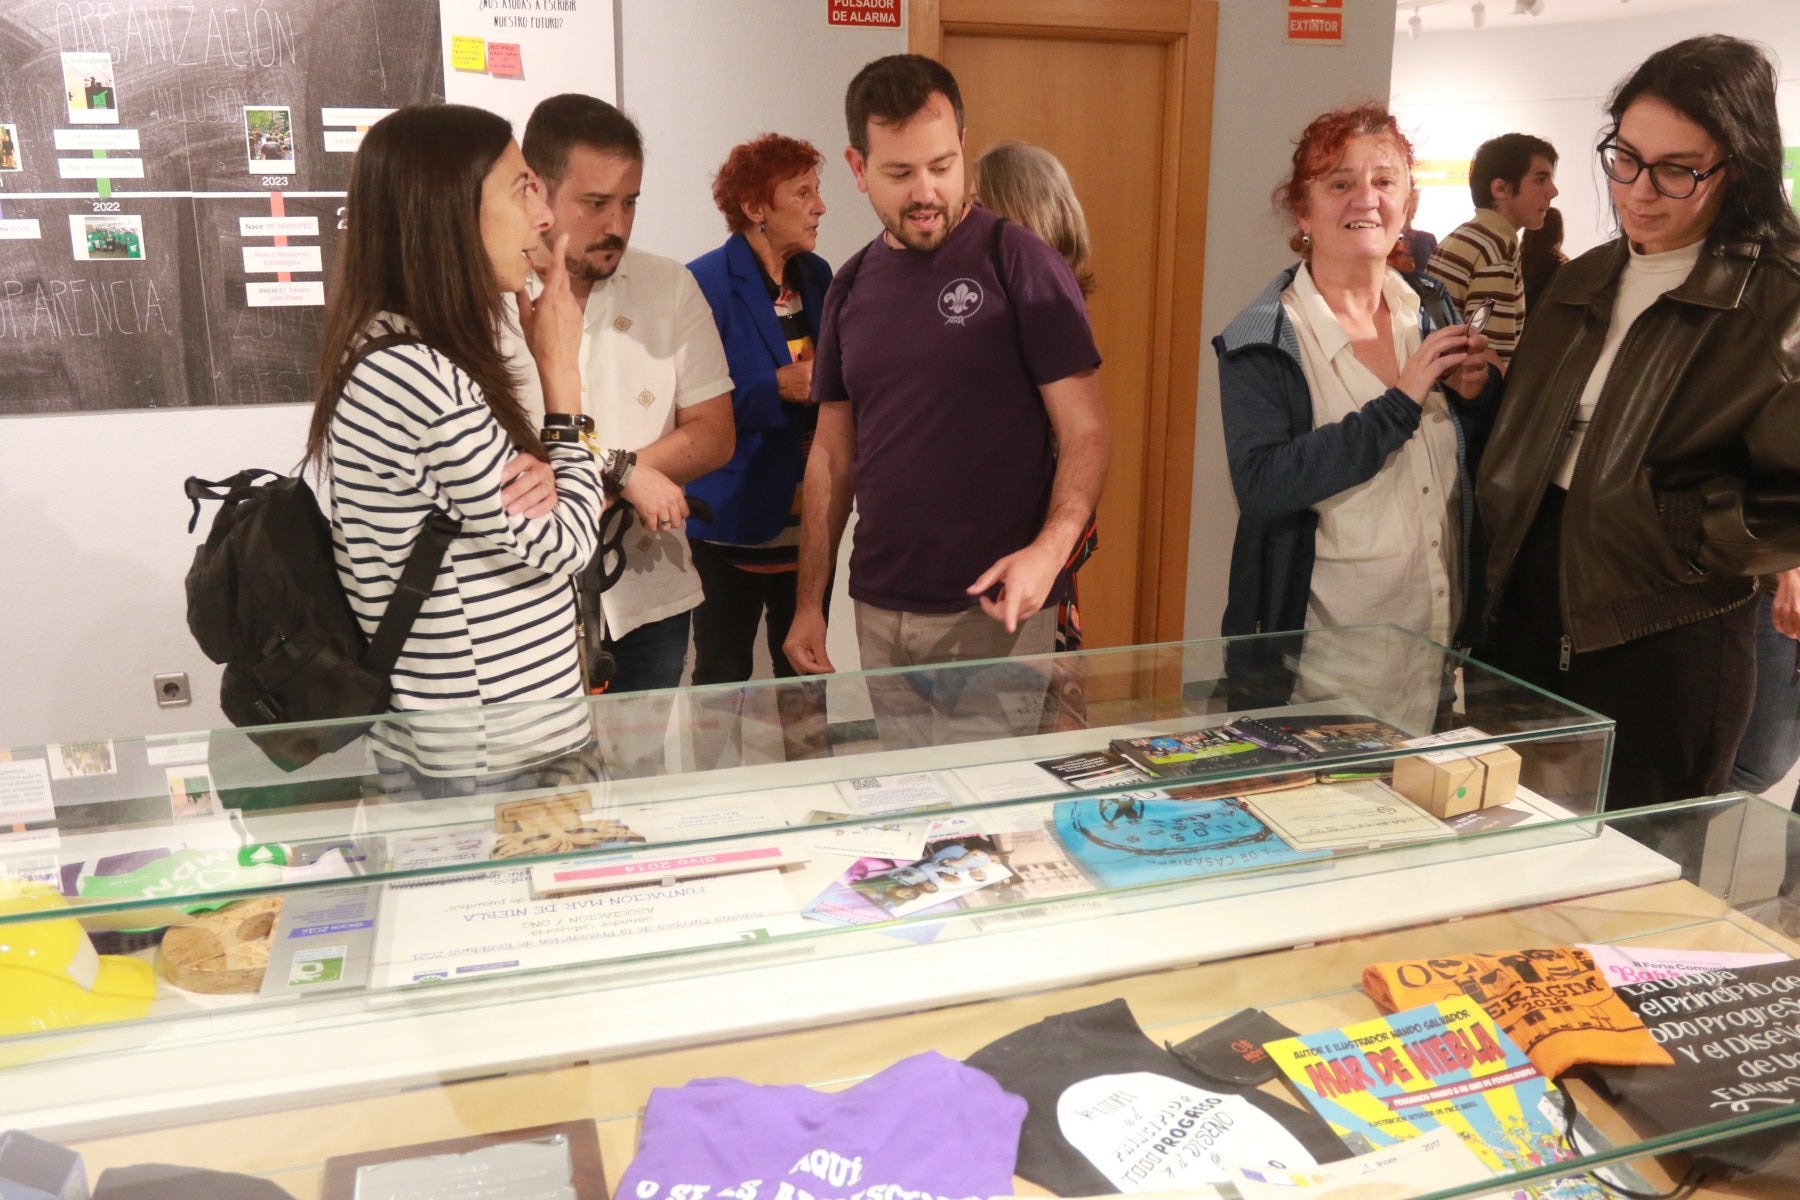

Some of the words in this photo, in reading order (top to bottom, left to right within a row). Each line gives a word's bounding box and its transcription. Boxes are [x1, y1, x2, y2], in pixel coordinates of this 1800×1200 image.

[834, 0, 894, 8] PULSADOR
[494, 16, 527, 28] NUESTRO
[531, 16, 564, 29] FUTURO?
[833, 11, 847, 21] DE
[850, 11, 896, 23] ALARMA
[1290, 20, 1338, 32] EXTINTOR
[262, 176, 289, 186] 2023
[93, 202, 121, 212] 2022
[0, 278, 170, 341] PARENCIA
[1238, 850, 1257, 862] DE
[623, 860, 672, 874] 2014
[534, 904, 558, 914] DE
[564, 899, 604, 911] MAR
[463, 908, 528, 922] NIEBLA
[521, 919, 552, 930] ONG
[657, 918, 711, 931] Europea
[448, 942, 513, 957] Residuos
[519, 940, 534, 949] de
[412, 951, 445, 961] 2021
[1642, 961, 1675, 970] Feria
[1486, 976, 1603, 1020] ERAGIM
[1639, 999, 1667, 1017] el
[1294, 1045, 1325, 1060] AUTOR
[1325, 1045, 1332, 1053] E
[1333, 1032, 1390, 1053] ILUSTRADOR
[1391, 1023, 1423, 1040] NANDO
[1423, 1009, 1470, 1031] SALVADOR
[1702, 1041, 1731, 1059] el
[1304, 1055, 1376, 1099] MAR
[1363, 1046, 1414, 1087] DE
[1402, 1021, 1507, 1081] NIEBLA
[1737, 1060, 1776, 1078] de
[1483, 1078, 1492, 1088] DE
[1492, 1067, 1537, 1087] POSIBILIDADES
[1370, 1113, 1407, 1127] ILUSTRACIÓN
[1408, 1109, 1436, 1120] INTERIOR
[1436, 1107, 1444, 1116] DE
[1422, 1139, 1441, 1152] 2017
[787, 1149, 862, 1188] AQUÍ
